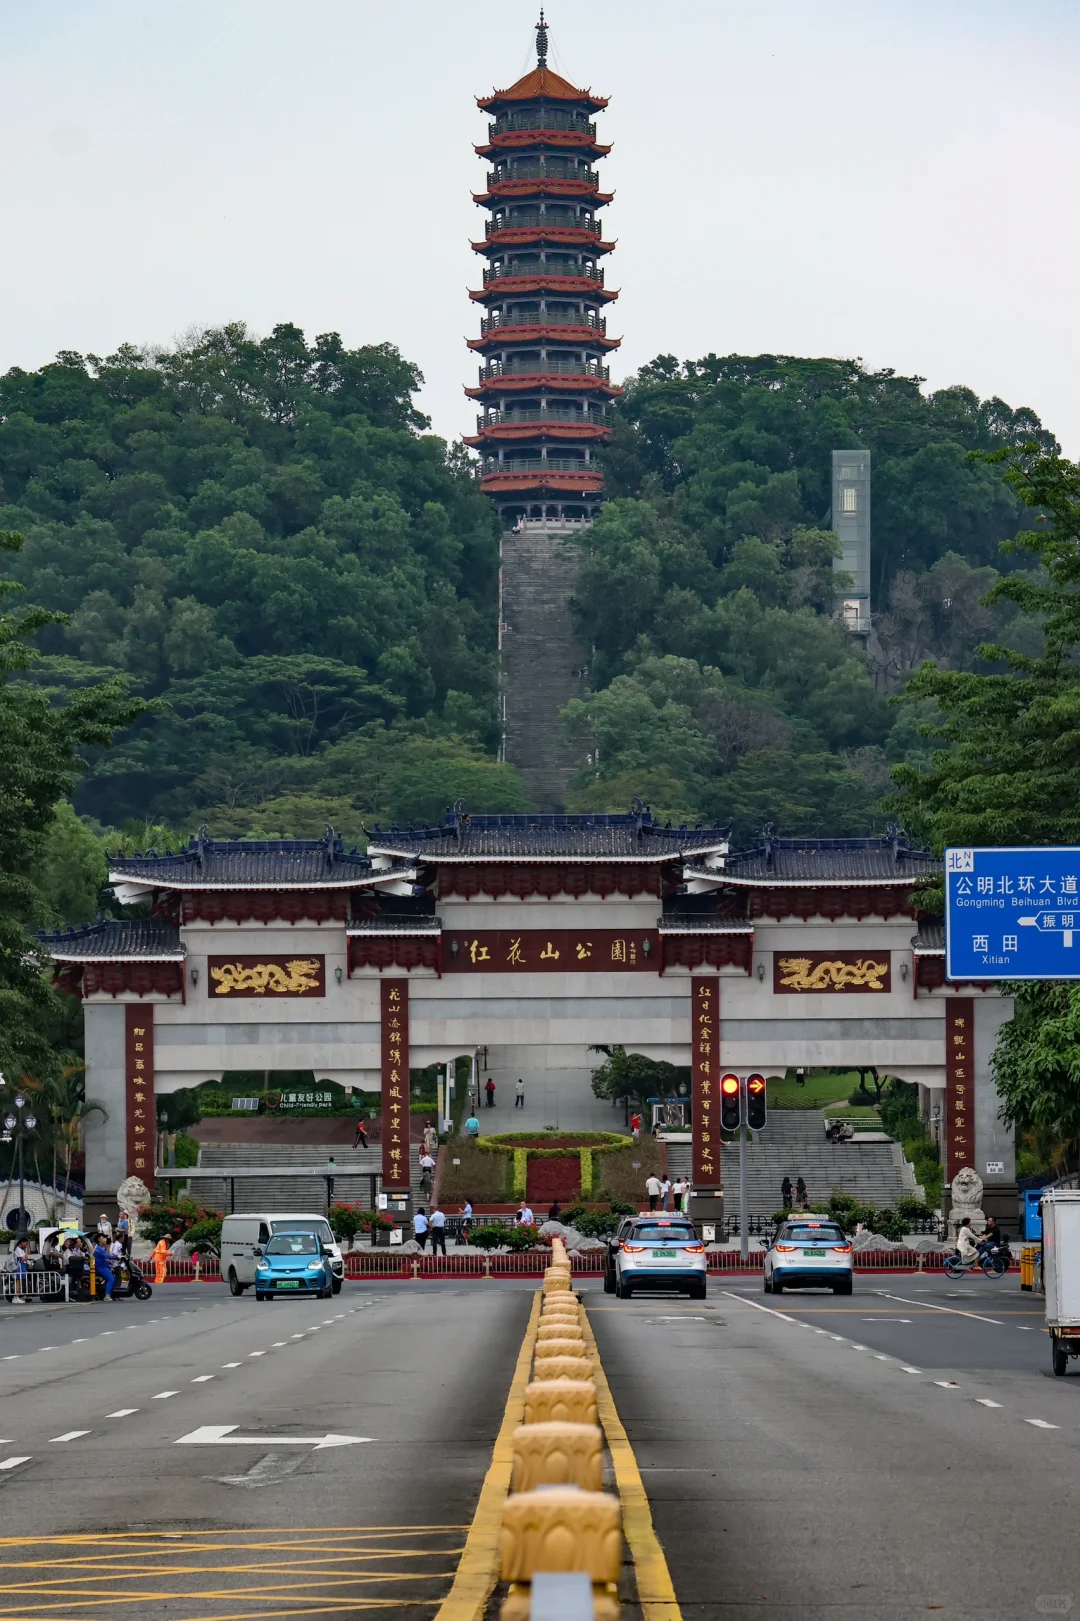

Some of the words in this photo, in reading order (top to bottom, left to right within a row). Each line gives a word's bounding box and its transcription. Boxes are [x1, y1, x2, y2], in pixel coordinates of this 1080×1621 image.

[949, 853, 962, 869] 北
[964, 851, 971, 859] N
[956, 875, 1078, 894] 公明北环大道
[956, 897, 1005, 908] Gongming
[1011, 897, 1051, 906] Beihuan
[1057, 896, 1078, 906] Blvd
[1042, 914, 1074, 928] 振明
[972, 935, 1018, 952] 西田
[982, 955, 1010, 964] Xitian
[280, 1092, 332, 1102] 儿童友好公园
